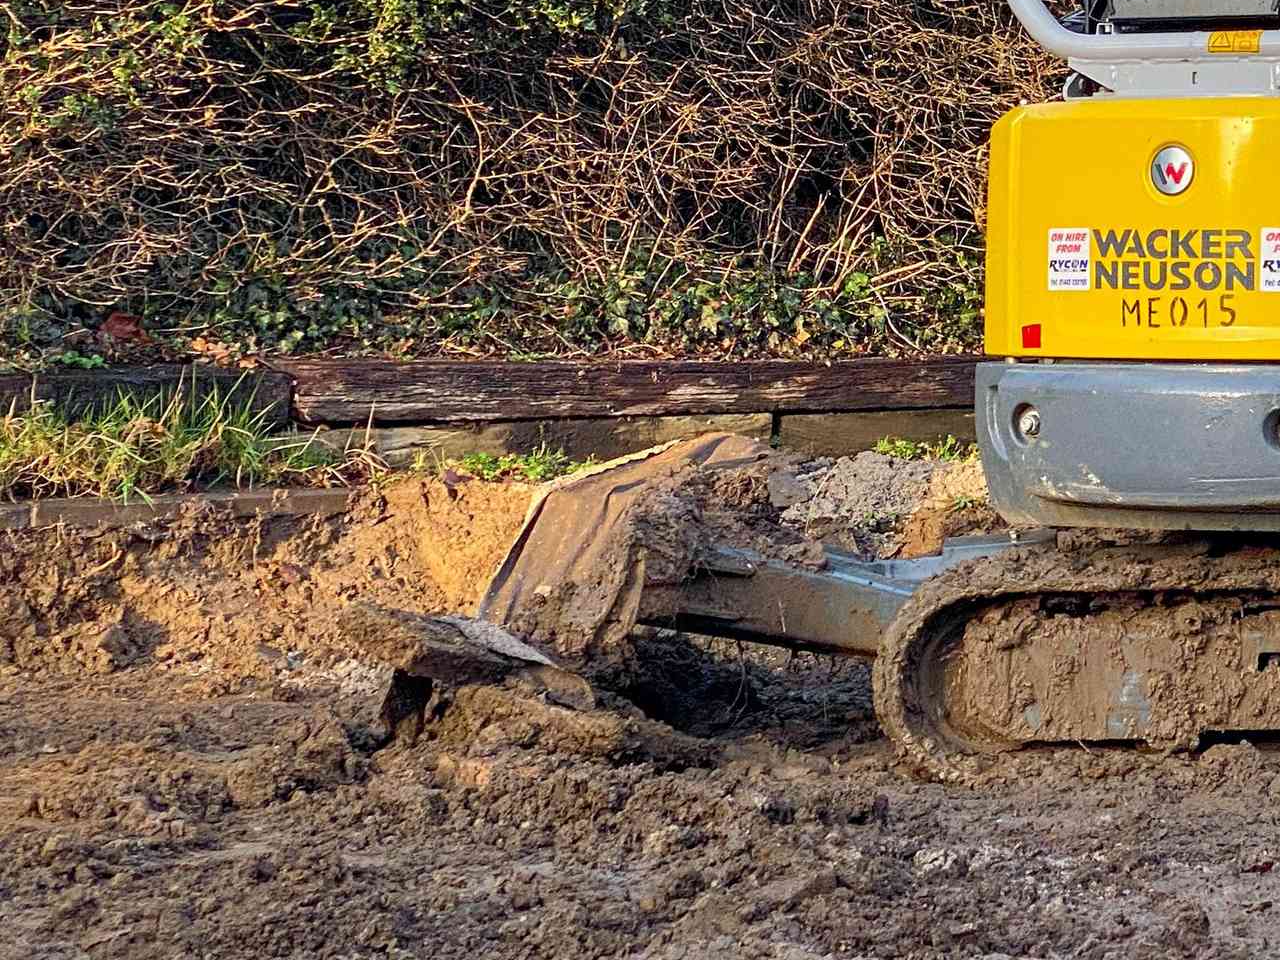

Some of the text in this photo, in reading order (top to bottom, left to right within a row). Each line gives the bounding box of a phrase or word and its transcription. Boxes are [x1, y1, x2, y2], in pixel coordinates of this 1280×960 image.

[1065, 232, 1087, 242] HIRE
[1092, 229, 1255, 259] WACKER
[1056, 244, 1081, 253] FROM
[1049, 259, 1088, 272] RYCON
[1095, 260, 1255, 291] NEUSON
[1121, 294, 1237, 329] ME015
